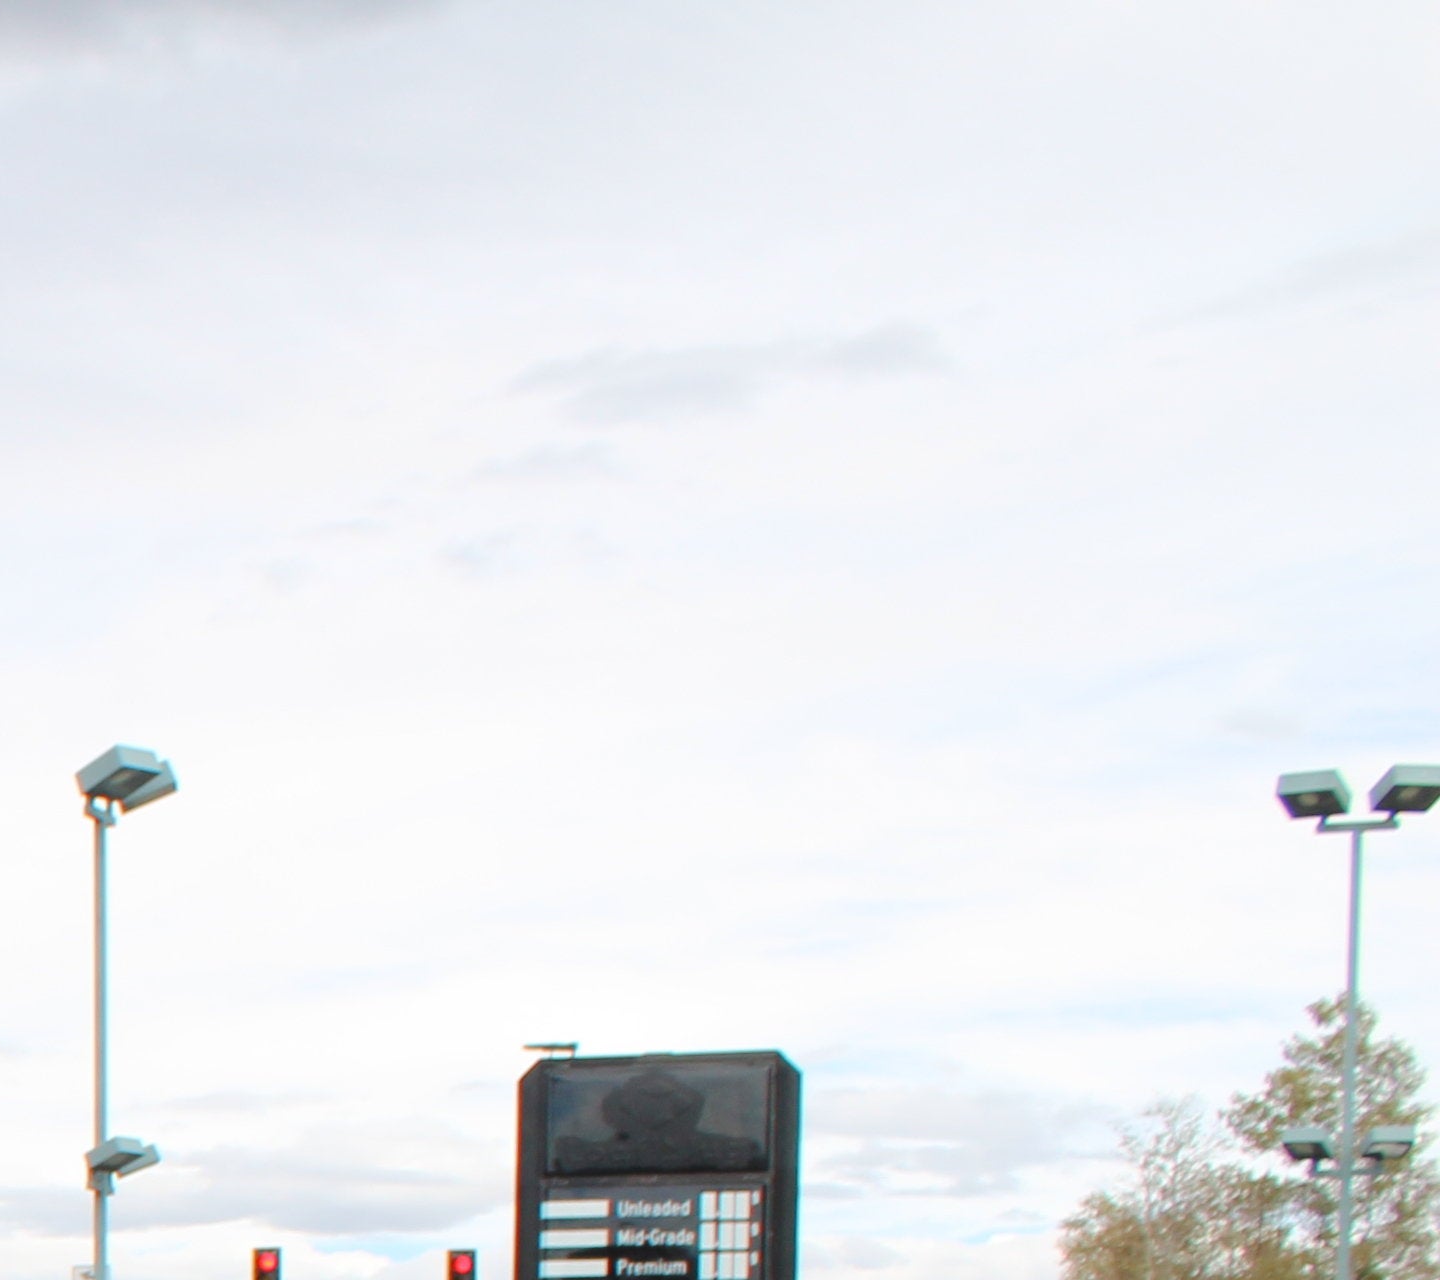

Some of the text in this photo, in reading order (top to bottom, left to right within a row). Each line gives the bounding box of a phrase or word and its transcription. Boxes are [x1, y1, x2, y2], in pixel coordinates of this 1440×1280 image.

[616, 1199, 692, 1217] Unleaded
[616, 1228, 697, 1246] Mid-Grade
[616, 1258, 688, 1276] Premium
